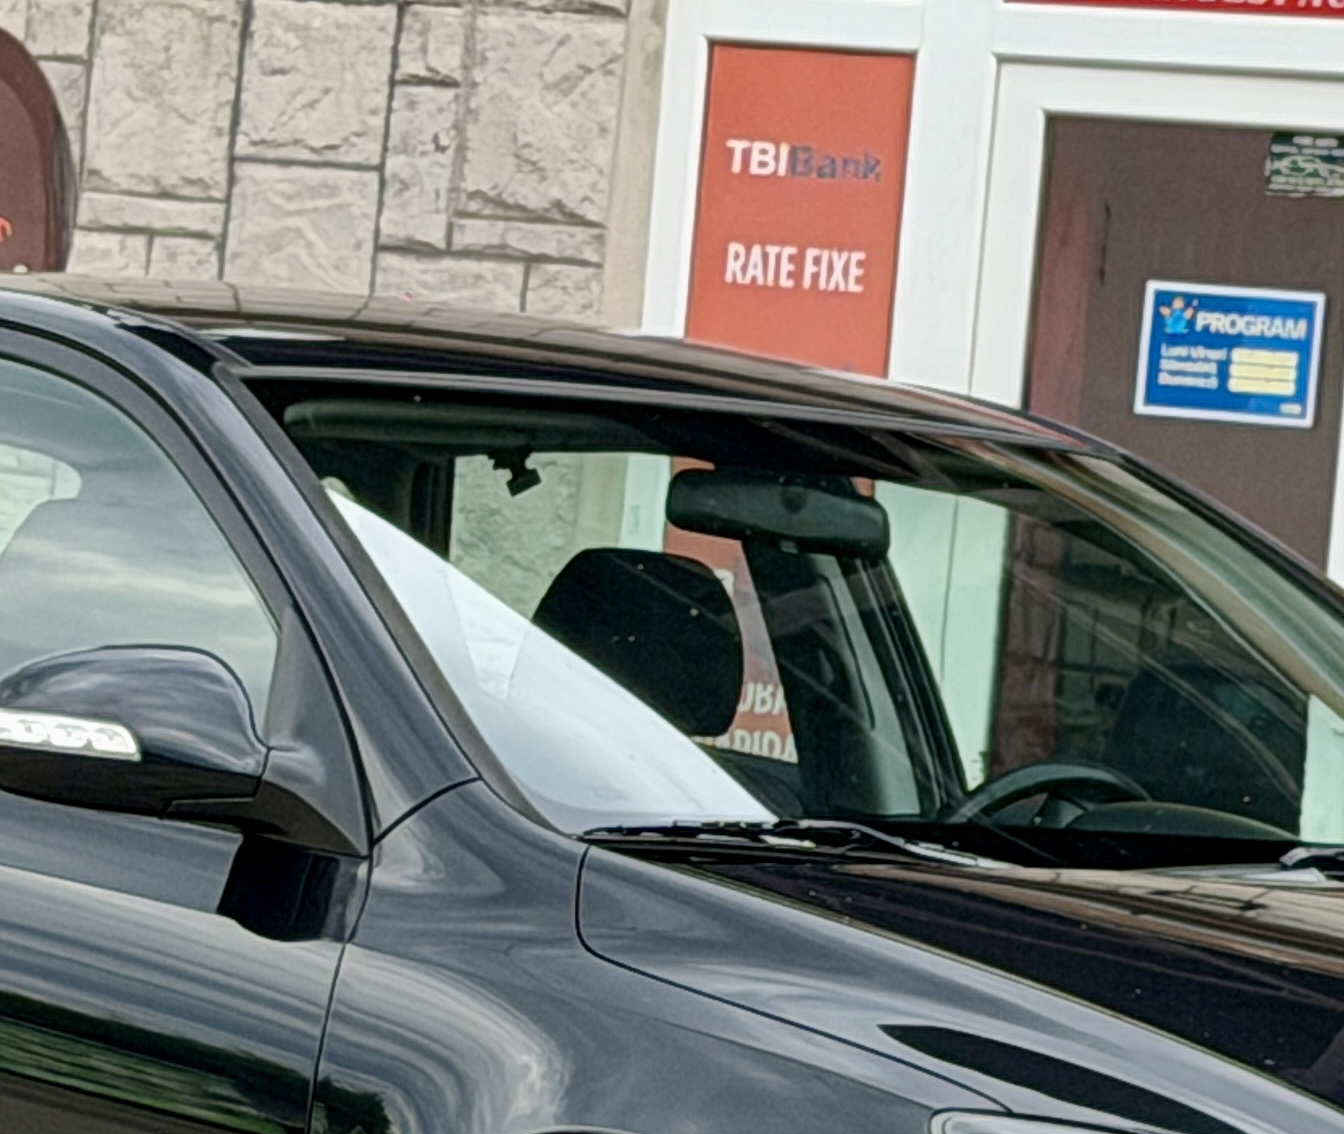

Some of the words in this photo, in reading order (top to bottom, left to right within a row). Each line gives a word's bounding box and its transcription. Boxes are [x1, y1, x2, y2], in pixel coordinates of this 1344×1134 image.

[724, 241, 798, 288] RATE
[802, 247, 867, 293] FIXE
[1195, 311, 1308, 341] PROGRAM
